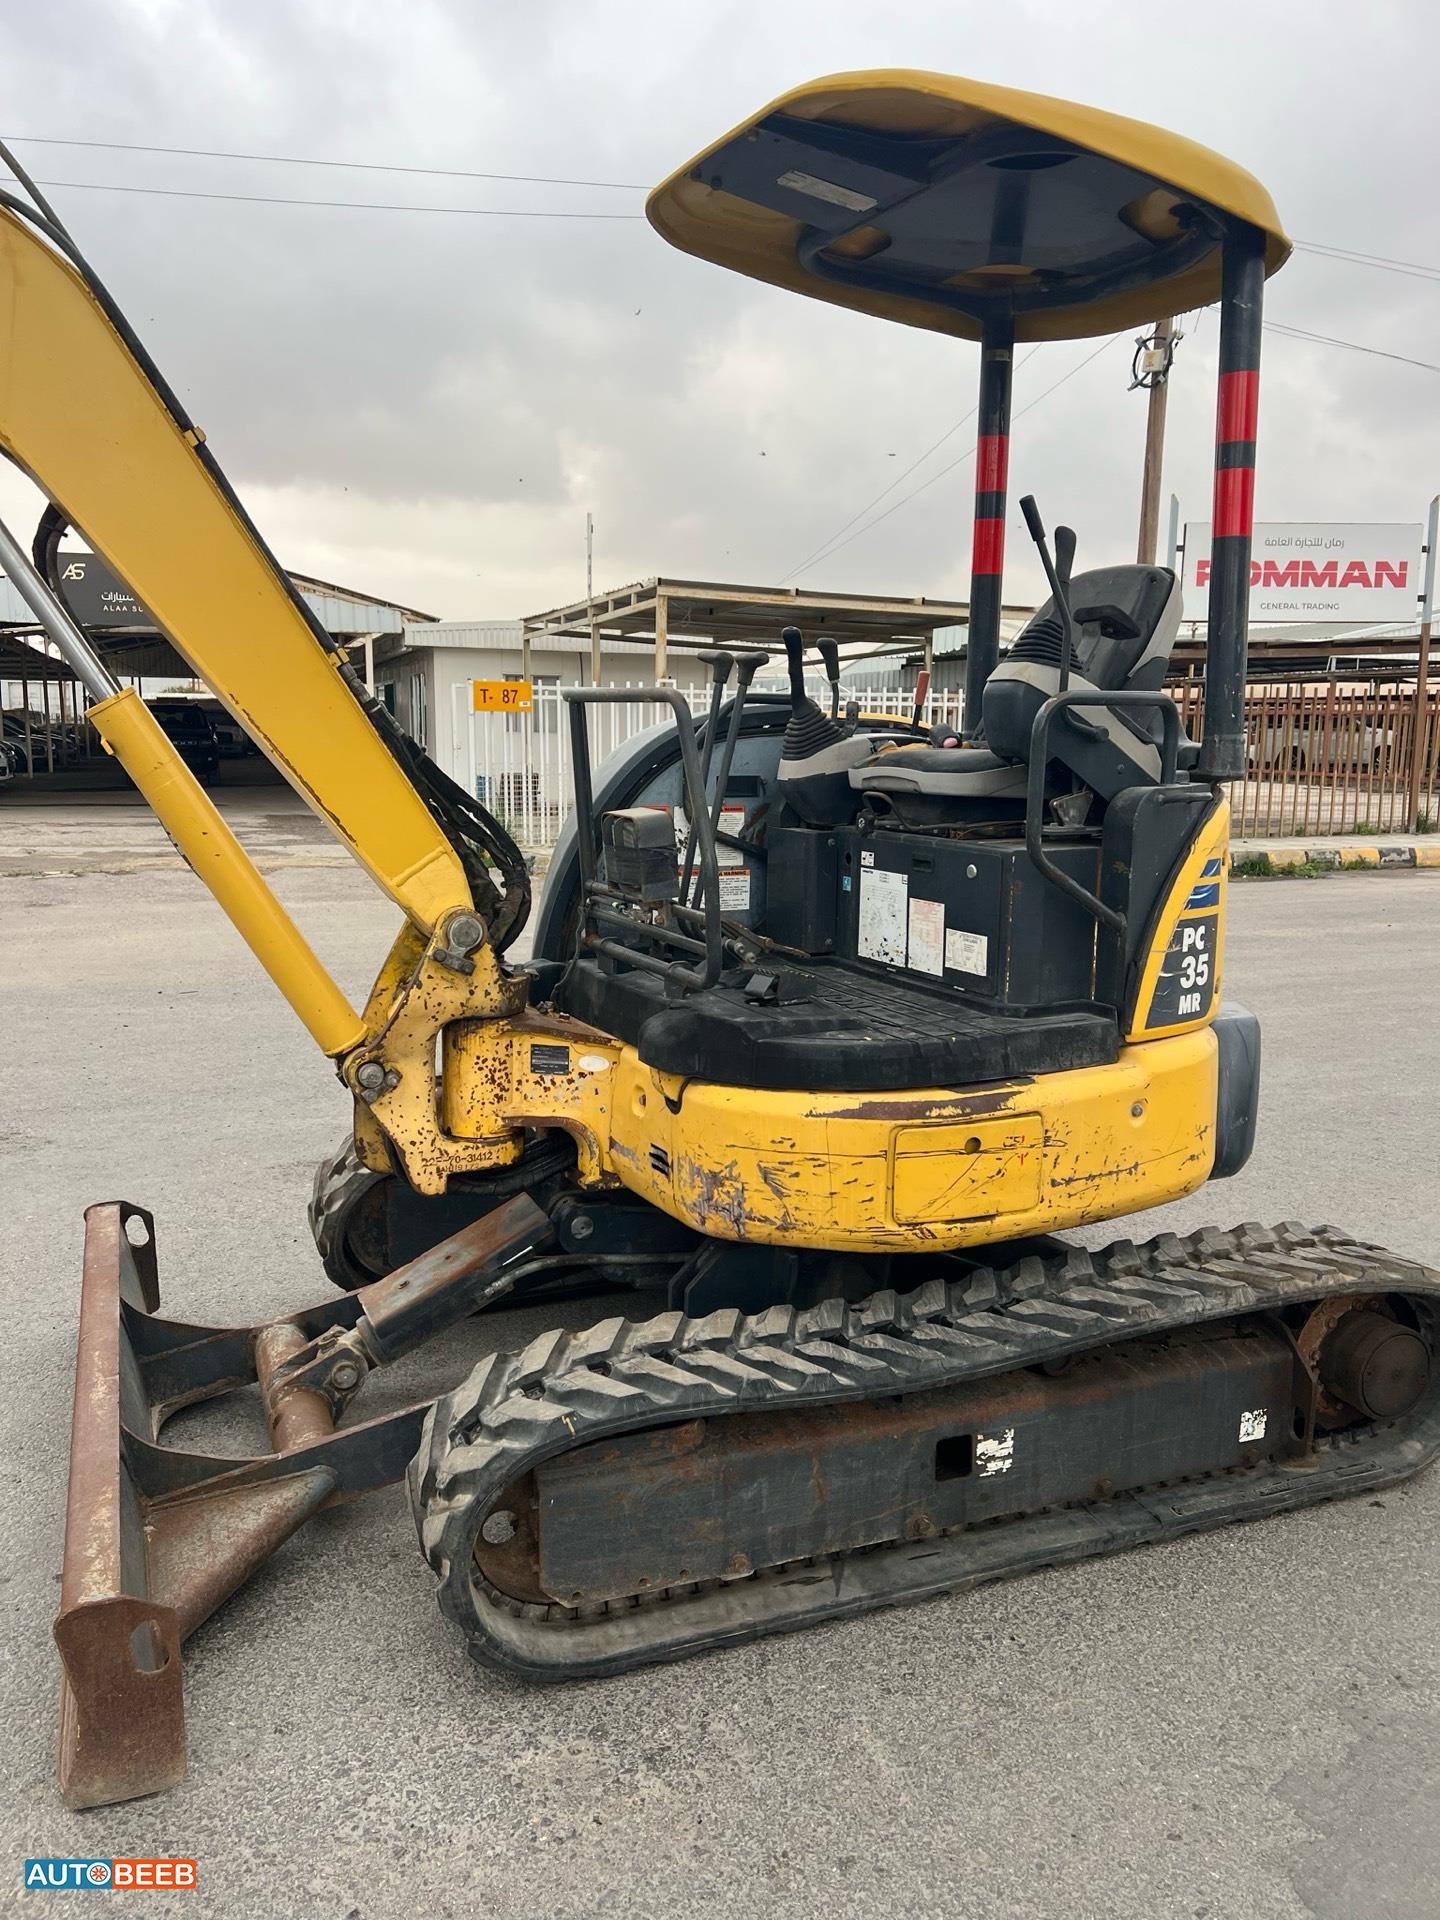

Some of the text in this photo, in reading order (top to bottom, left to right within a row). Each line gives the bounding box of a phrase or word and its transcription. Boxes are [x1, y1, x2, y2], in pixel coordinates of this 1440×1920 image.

[1265, 537, 1344, 549] رمان للتجارة العامة
[62, 563, 86, 580] AS
[1260, 602, 1340, 610] GENERAL TRADING
[480, 689, 518, 704] T- 87
[1182, 925, 1206, 952] PC
[1180, 953, 1209, 989] 35
[1178, 992, 1201, 1015] MR
